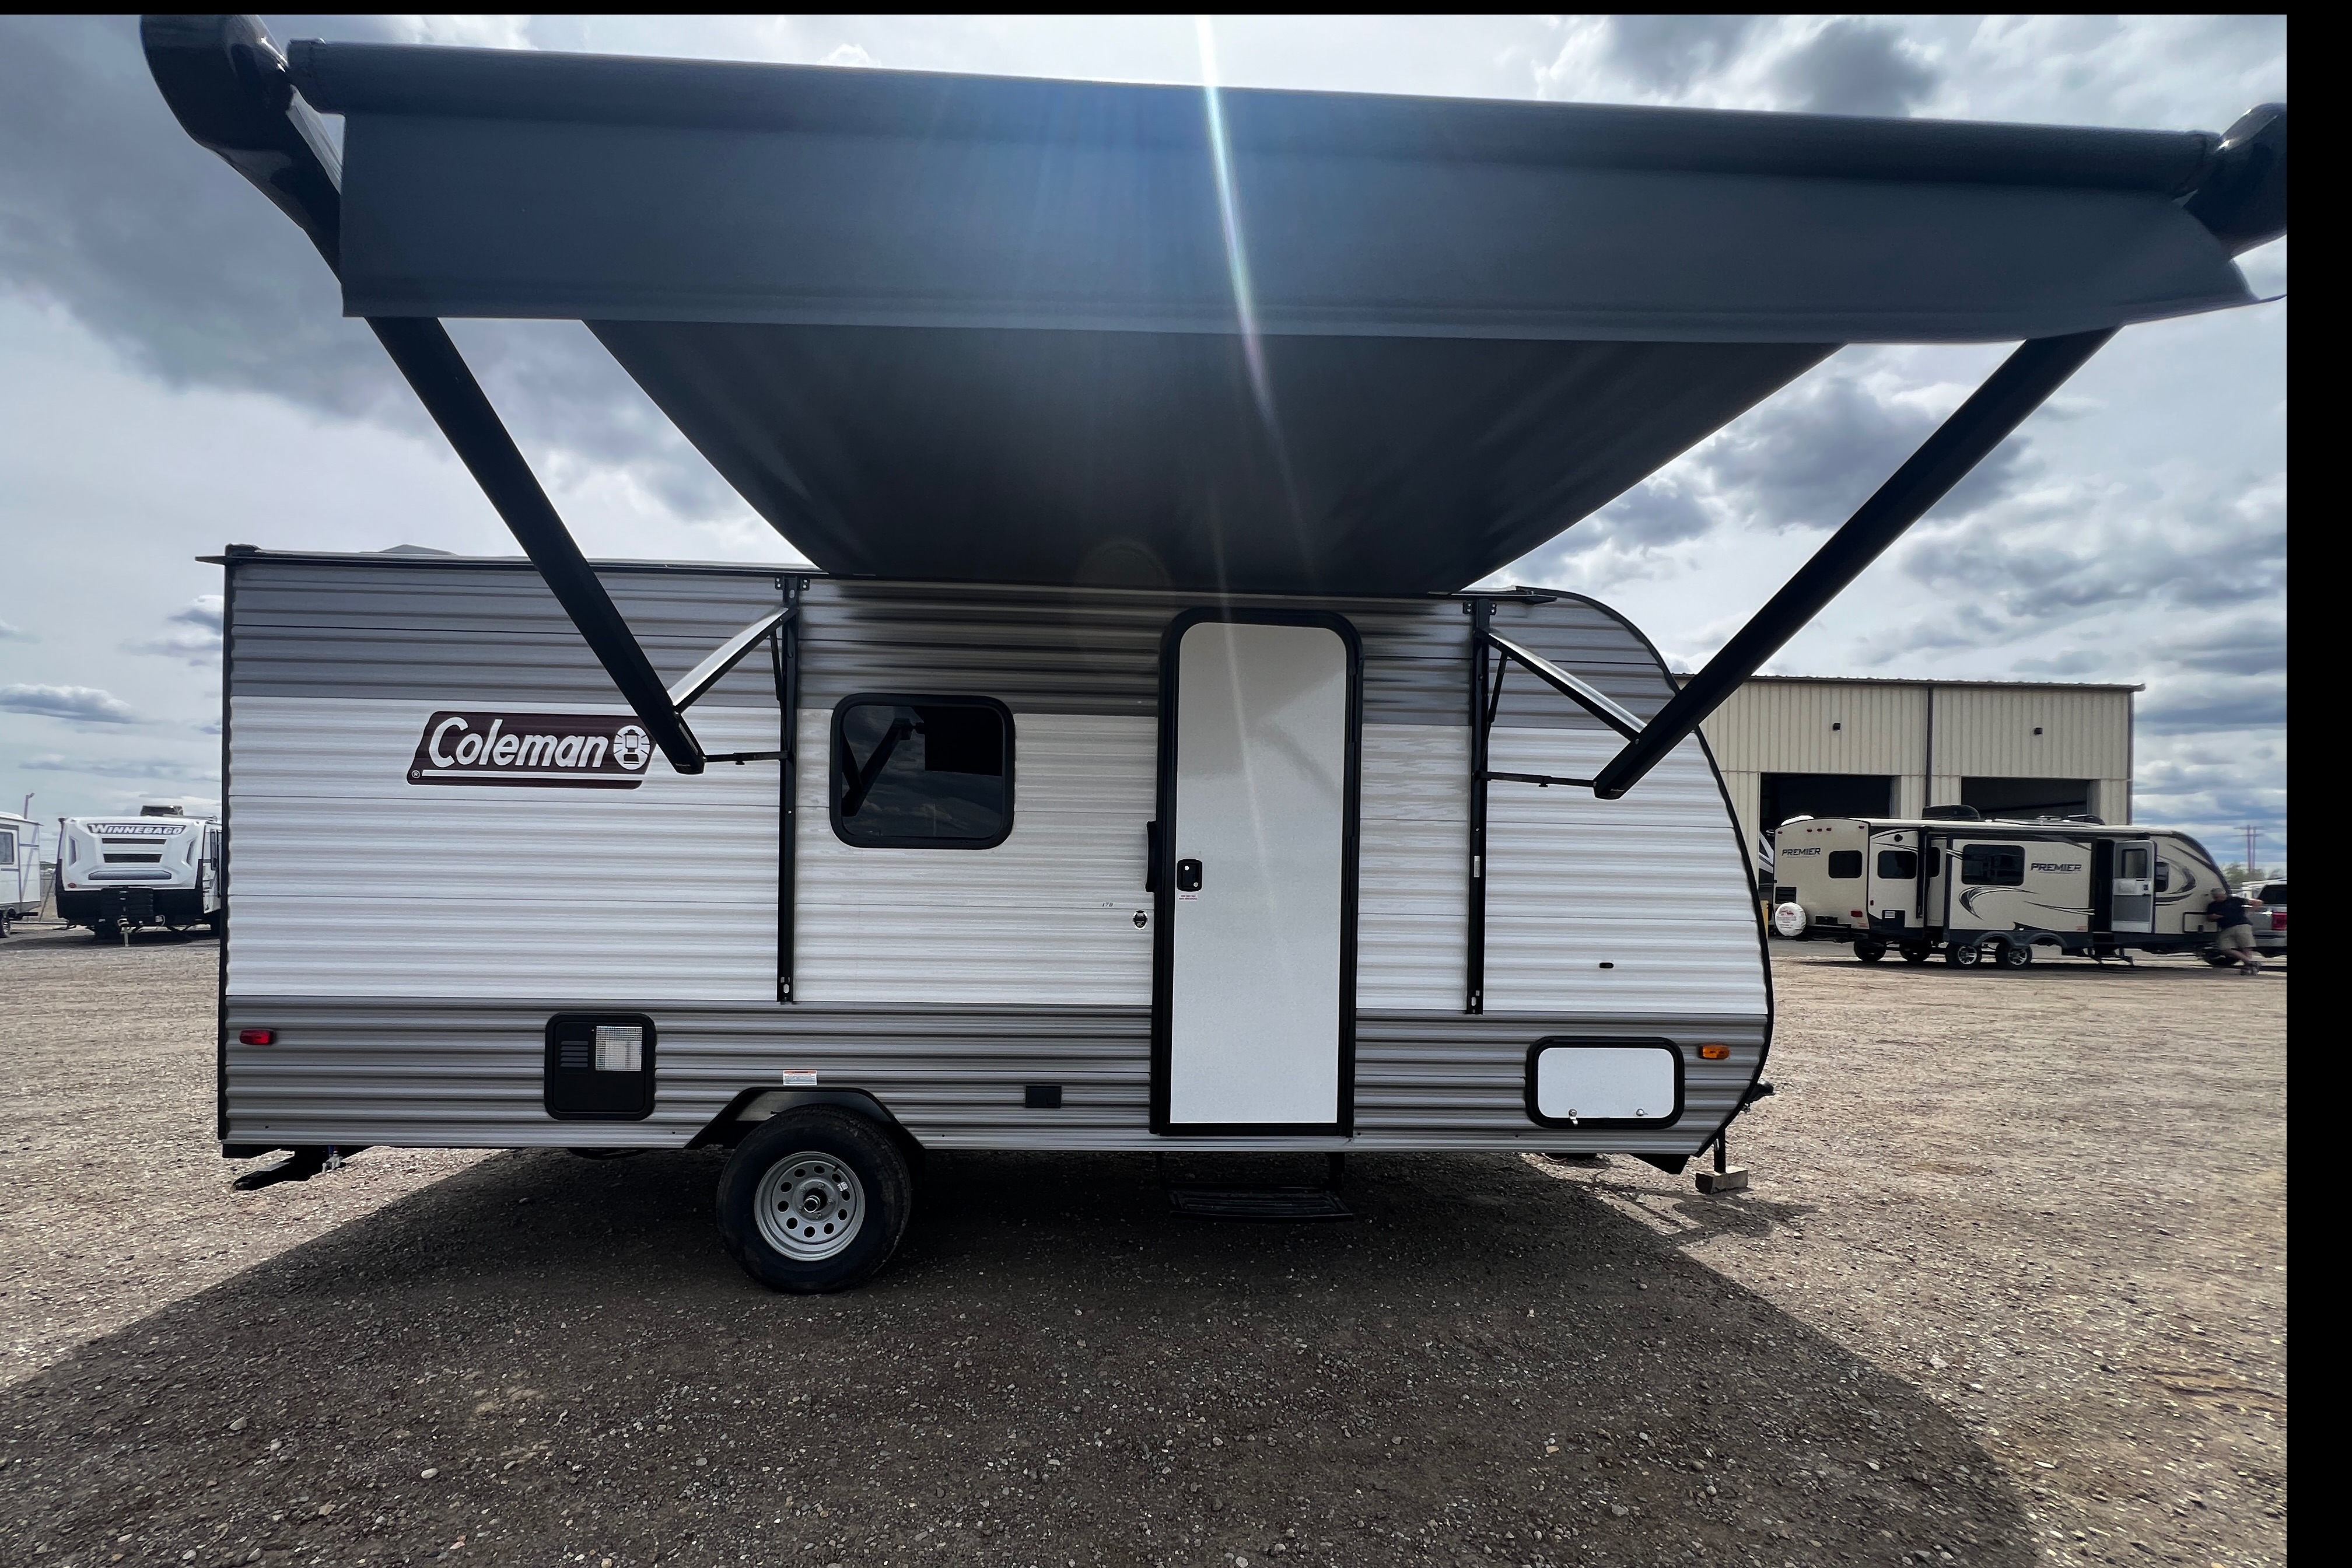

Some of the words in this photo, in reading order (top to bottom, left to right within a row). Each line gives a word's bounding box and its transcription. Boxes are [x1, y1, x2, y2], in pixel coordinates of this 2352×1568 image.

[429, 716, 609, 768] Coleman
[88, 824, 183, 834] WINNEBAGO
[1782, 848, 1821, 856] PREMIER
[2030, 863, 2082, 872] PREMIER
